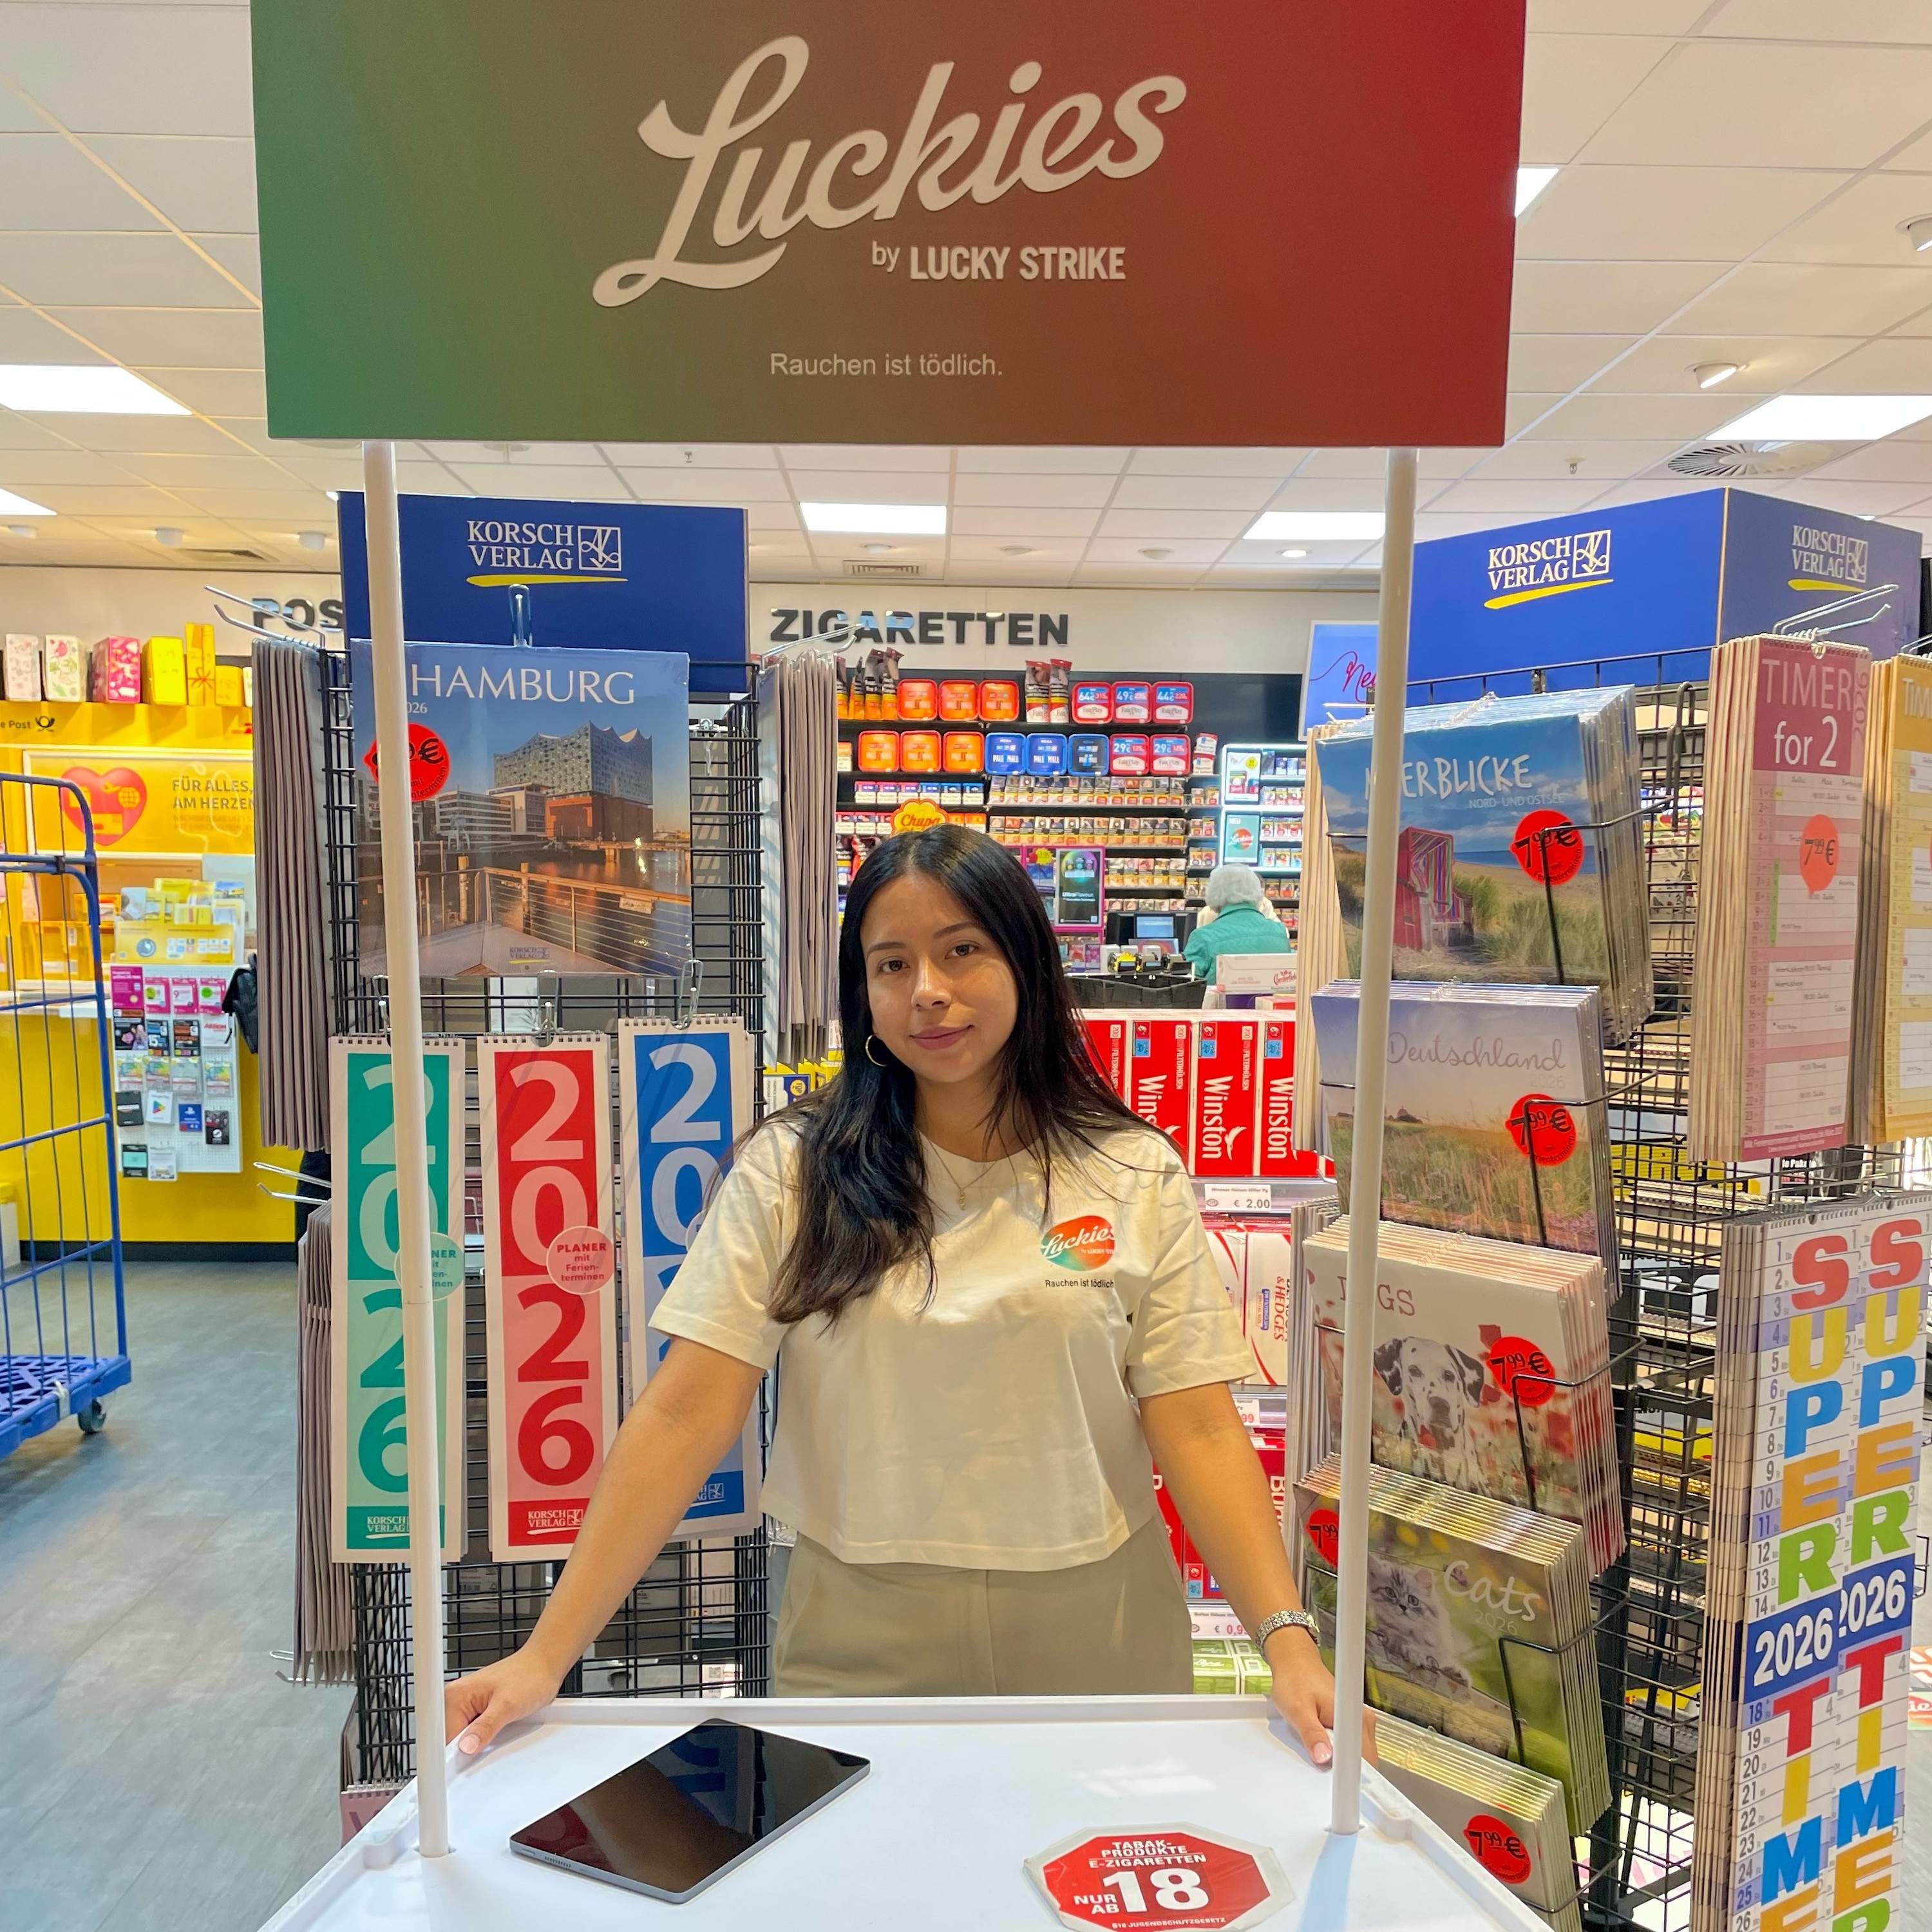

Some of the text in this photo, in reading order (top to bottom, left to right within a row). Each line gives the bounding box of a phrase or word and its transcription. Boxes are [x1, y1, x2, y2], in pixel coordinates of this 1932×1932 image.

[592, 35, 1187, 307] Luckies
[872, 241, 1126, 280] by LUCKY STRIKE
[770, 352, 1003, 376] Rauchen ist tödlich.
[467, 520, 574, 547] KORSCH
[1792, 525, 1846, 555] KORSCH
[468, 544, 574, 571] VERLAG
[1488, 535, 1573, 569] KORSCH
[1792, 549, 1844, 578] VERLAG
[1488, 560, 1569, 590] VERLAG
[252, 598, 345, 632] POS
[770, 608, 1068, 645] ZIGARETTEN
[411, 663, 635, 706] HAMBURG
[1761, 658, 1853, 711] TIMER
[407, 701, 428, 714] 026
[1853, 672, 1868, 742] 2026
[1774, 715, 1839, 768] for 2
[173, 776, 254, 795] FÜR ALLES,
[1365, 753, 1533, 800] ERBLICKE
[173, 797, 196, 809] AM
[1469, 798, 1499, 810] NORD-
[1501, 797, 1524, 808] UND
[901, 814, 941, 827] Chupa
[1386, 1032, 1566, 1072] Deutschland
[1530, 1073, 1566, 1089] 2026
[1202, 1075, 1233, 1159] Winston
[1267, 1076, 1294, 1159] Winston
[1246, 1198, 1271, 1208] 2.00
[557, 1242, 607, 1253] PLANER
[1777, 1241, 1783, 1262] 1
[561, 1273, 605, 1282] terminen
[1045, 1278, 1079, 1288] Rauchen
[1080, 1278, 1089, 1287] ist
[1775, 1268, 1782, 1290] 2
[1274, 1285, 1285, 1341] HEDGES
[1774, 1296, 1781, 1318] 3
[1772, 1323, 1780, 1345] 4
[1771, 1351, 1779, 1372] 5
[1770, 1378, 1778, 1400] 6
[1769, 1406, 1777, 1427] 7
[1767, 1433, 1776, 1454] 8
[1766, 1460, 1774, 1481] 9
[1760, 1487, 1772, 1510] 10
[366, 1516, 406, 1525] KORSCH
[527, 1510, 567, 1519] KORSCH
[528, 1518, 566, 1527] VERLAG
[367, 1524, 406, 1533] VERLAG
[1758, 1515, 1770, 1537] 11
[1757, 1542, 1770, 1564] 12
[1756, 1569, 1770, 1590] 13
[1443, 1560, 1541, 1622] Cats
[1755, 1595, 1768, 1616] 14
[1227, 1625, 1247, 1636] 0,9
[1475, 1610, 1519, 1636] 2026
[1753, 1605, 1833, 1687] 2026
[1749, 1701, 1763, 1725] 18
[1747, 1728, 1761, 1750] 19
[1743, 1754, 1759, 1779] 20
[1742, 1781, 1757, 1806] 21
[1740, 1808, 1757, 1832] 22
[1101, 1845, 1188, 1858] PRODUKTE
[1112, 1839, 1172, 1850] TABAK-
[1739, 1833, 1755, 1858] 23
[1088, 1855, 1207, 1869] E-ZIGARETTEN
[1738, 1859, 1753, 1884] 24
[1074, 1893, 1118, 1905] NUR
[1103, 1868, 1211, 1913] 18
[1737, 1885, 1753, 1910] 25
[1091, 1902, 1120, 1915] AB
[1128, 1917, 1226, 1927] JUGENDSCHUTZGESETZ
[1736, 1911, 1751, 1932] 26
